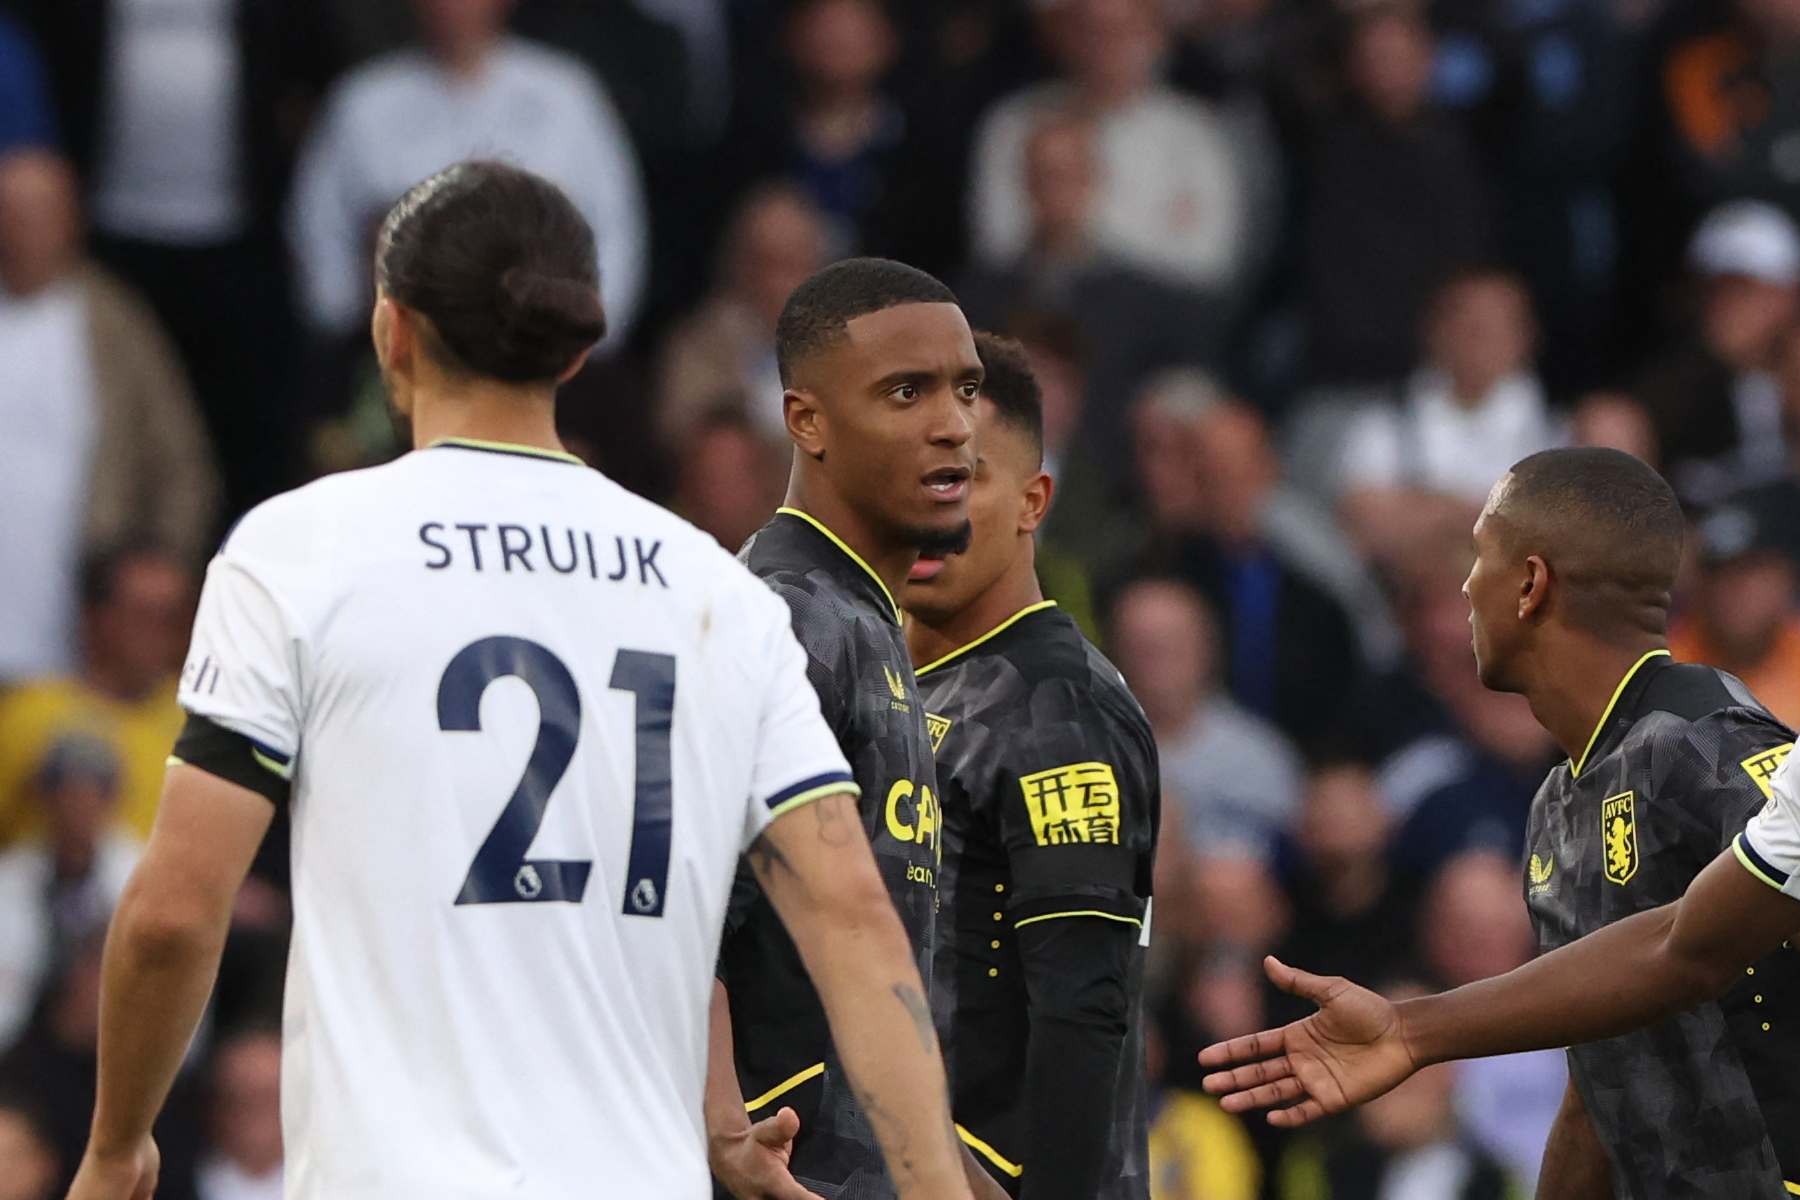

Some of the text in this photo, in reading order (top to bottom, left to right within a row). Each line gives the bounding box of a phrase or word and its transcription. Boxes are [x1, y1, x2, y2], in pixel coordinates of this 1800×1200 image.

[419, 522, 669, 588] STRUIJK
[437, 634, 677, 918] 21
[1027, 768, 1112, 818] 开云
[1605, 797, 1632, 820] AVFC
